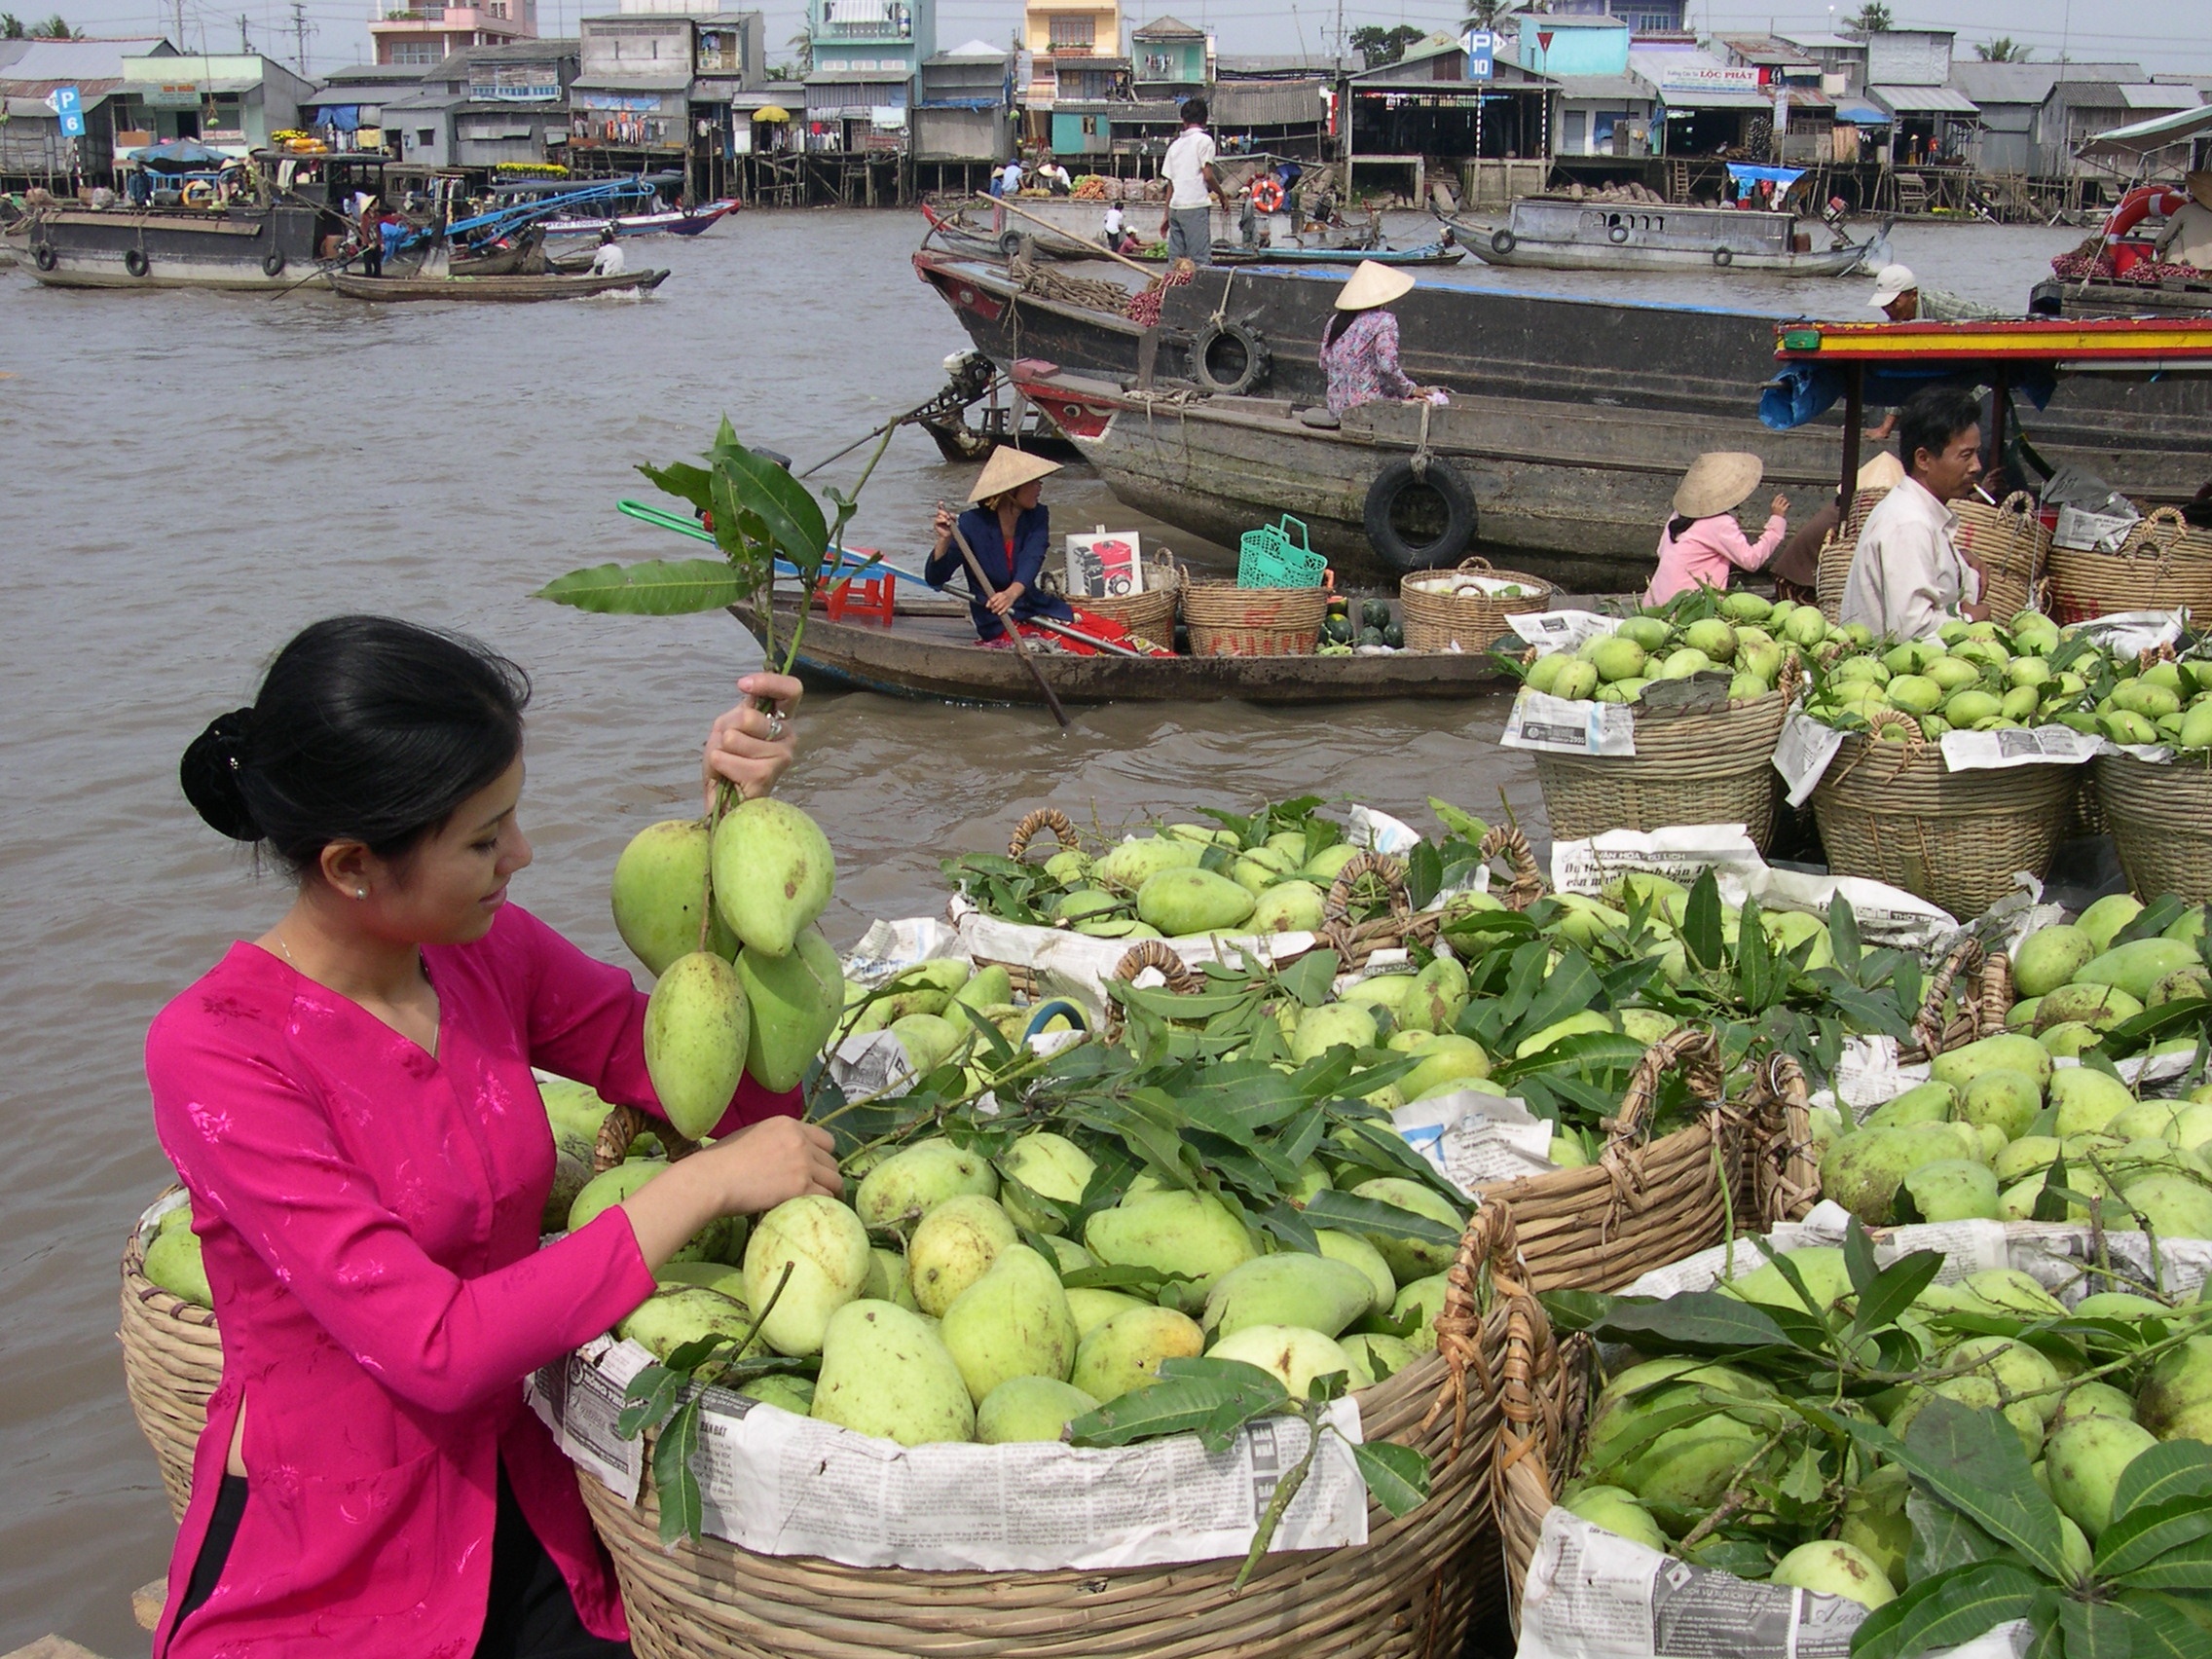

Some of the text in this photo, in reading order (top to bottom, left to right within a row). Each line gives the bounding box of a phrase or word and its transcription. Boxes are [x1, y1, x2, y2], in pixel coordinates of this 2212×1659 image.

[1472, 34, 1491, 53] P
[1473, 59, 1489, 75] 10
[61, 92, 75, 109] P
[67, 117, 78, 131] 6
